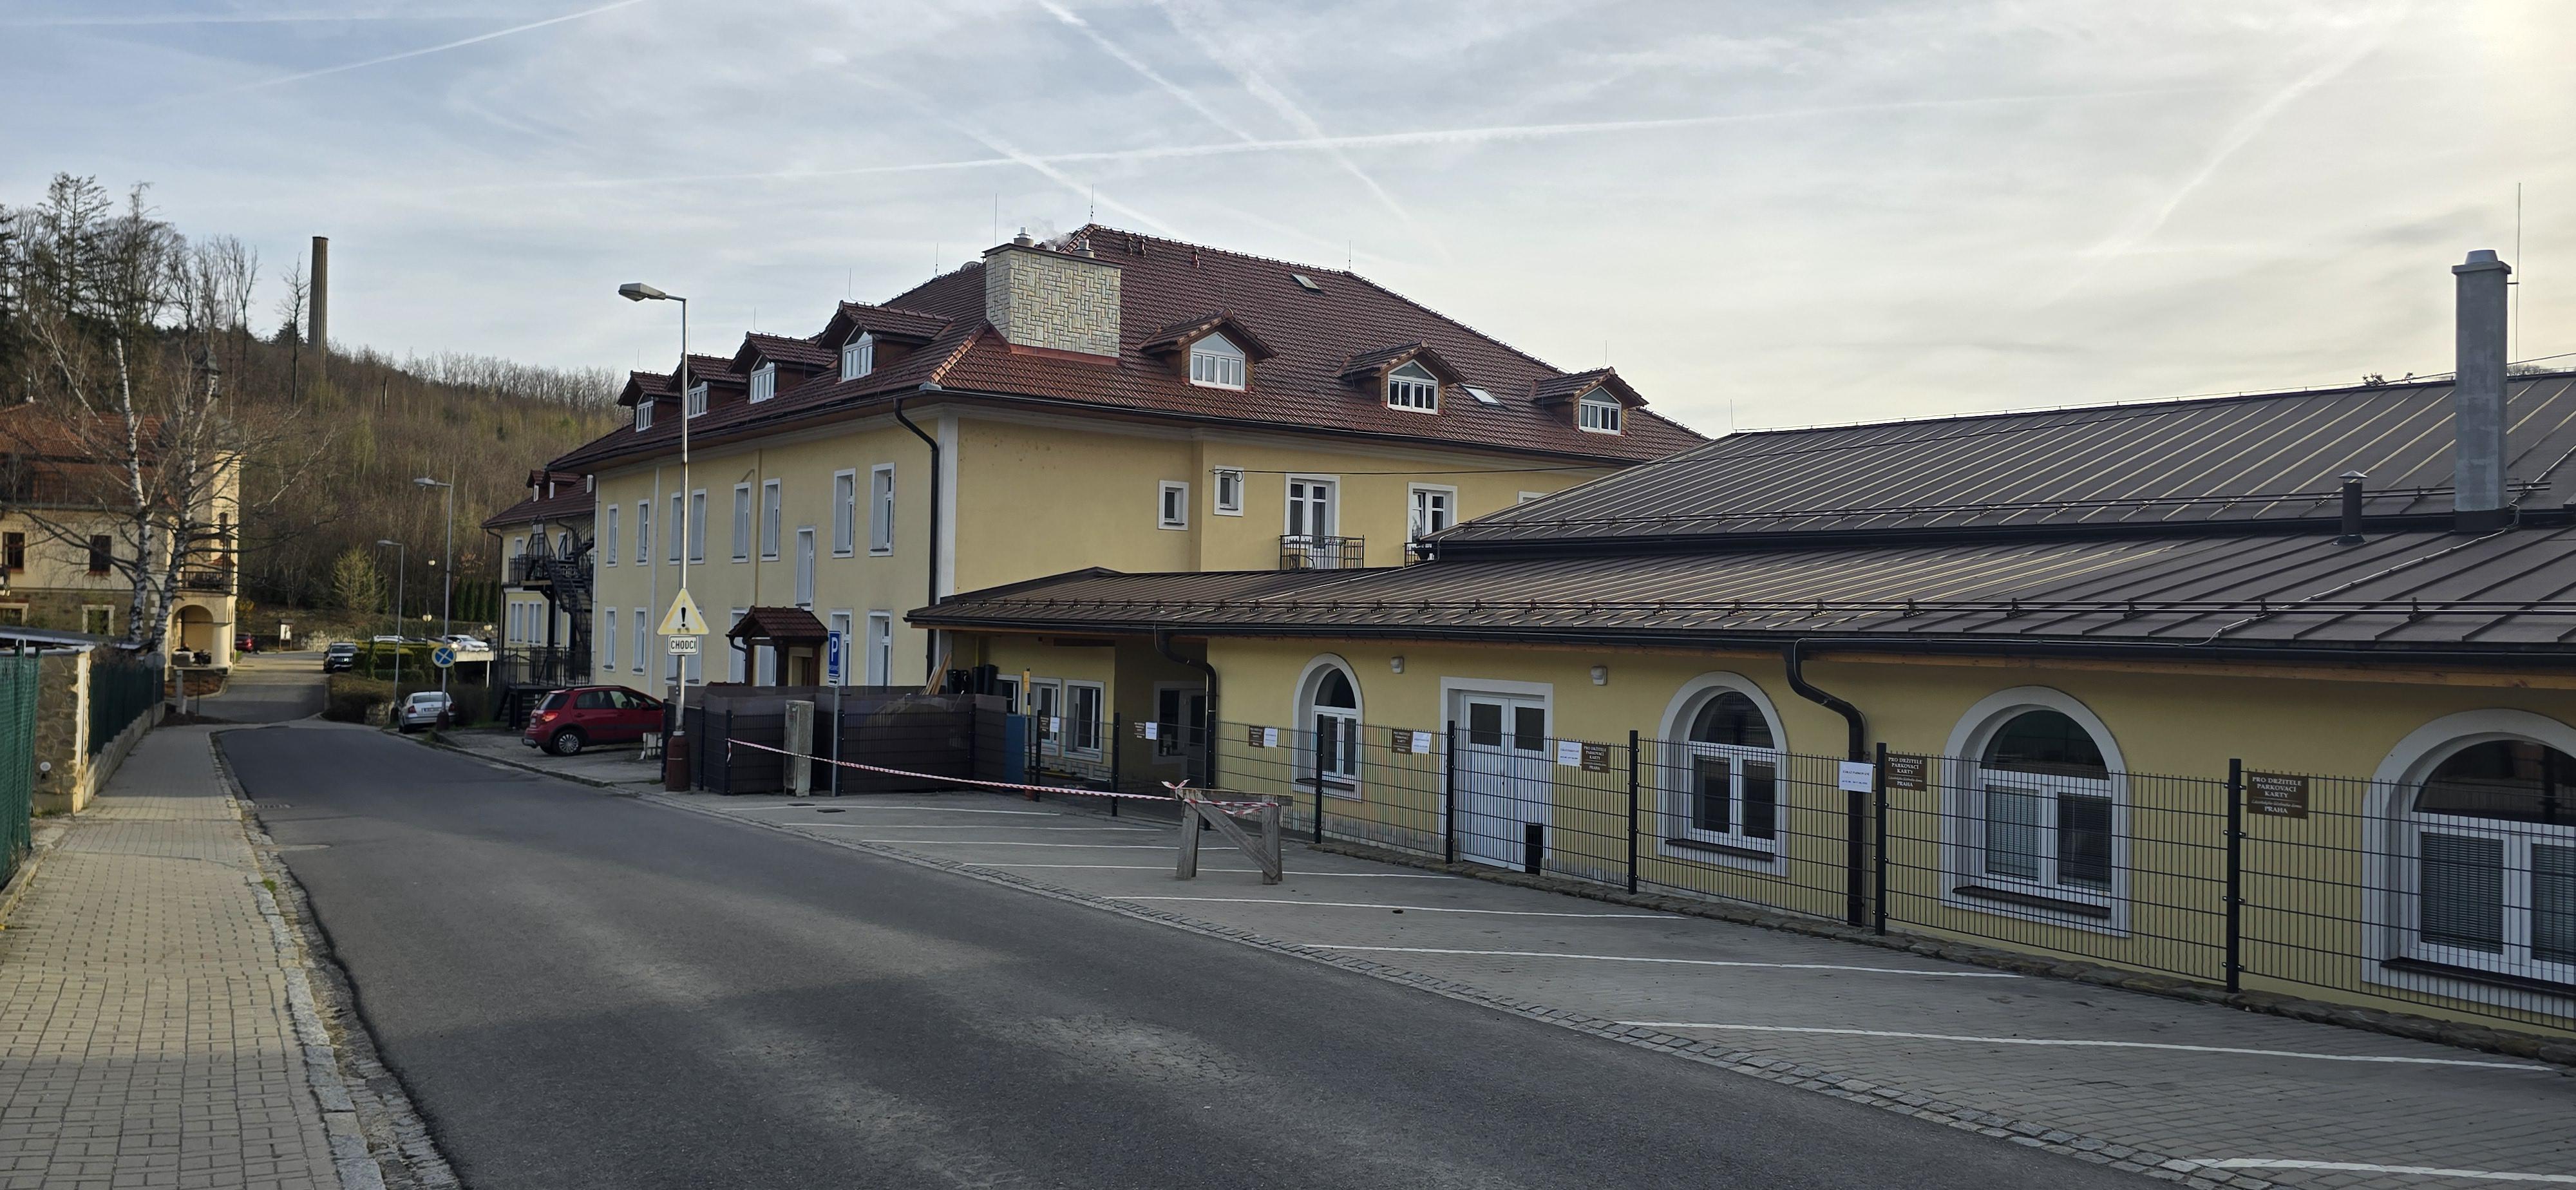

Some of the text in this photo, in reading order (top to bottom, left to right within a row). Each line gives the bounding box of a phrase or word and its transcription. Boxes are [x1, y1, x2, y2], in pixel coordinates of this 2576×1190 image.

[670, 640, 696, 649] CHODCI
[831, 637, 838, 662] P
[2268, 777, 2302, 786] DRŽITELE
[2257, 783, 2297, 792] PARKOVACÍ
